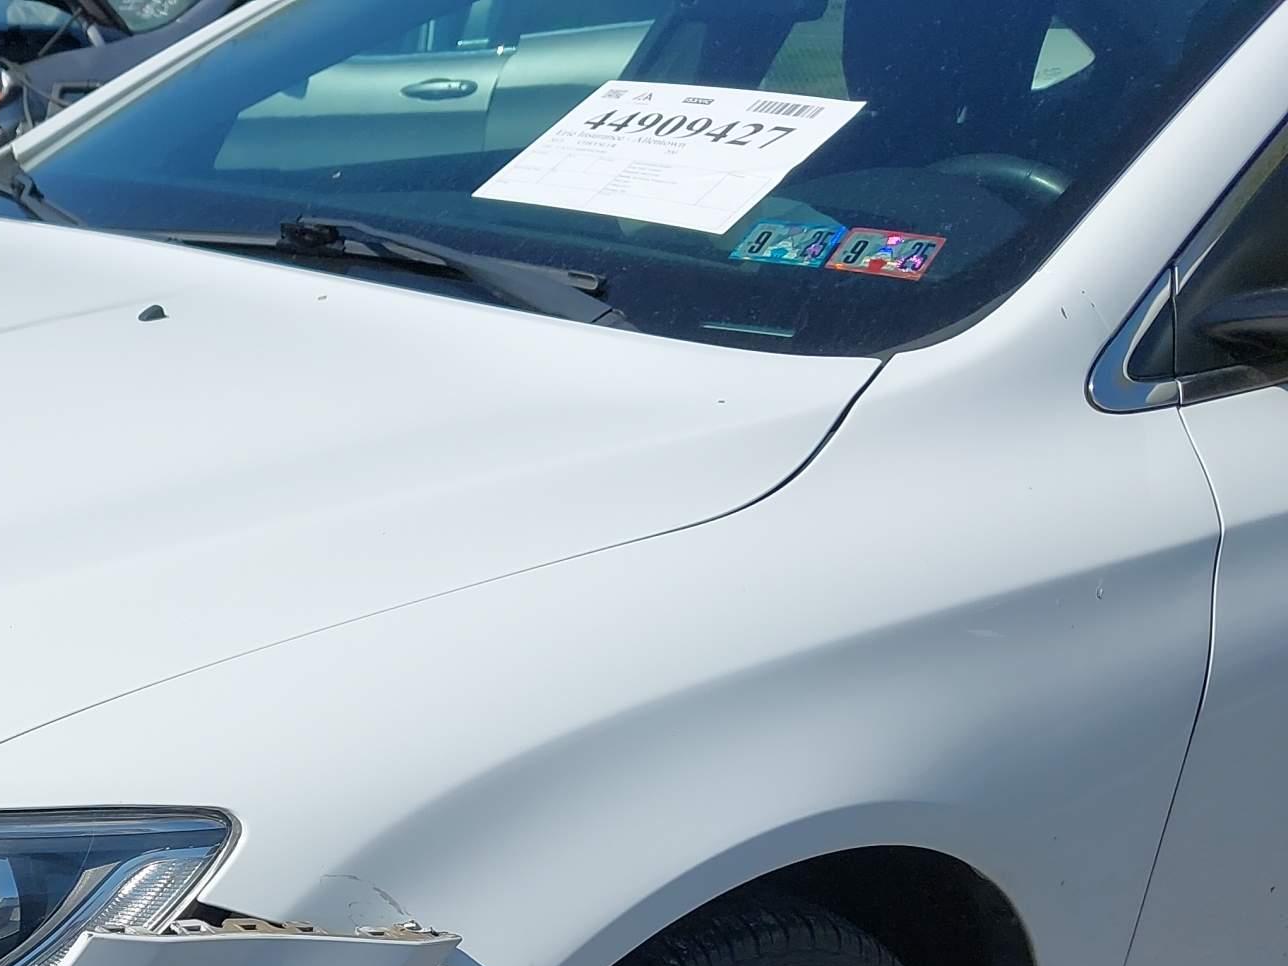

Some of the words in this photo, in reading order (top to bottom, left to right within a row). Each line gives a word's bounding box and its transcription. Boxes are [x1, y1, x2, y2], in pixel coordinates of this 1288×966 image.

[584, 110, 797, 149] 44909427
[748, 231, 772, 254] 9
[843, 240, 869, 264] 9
[899, 242, 936, 271] 25
